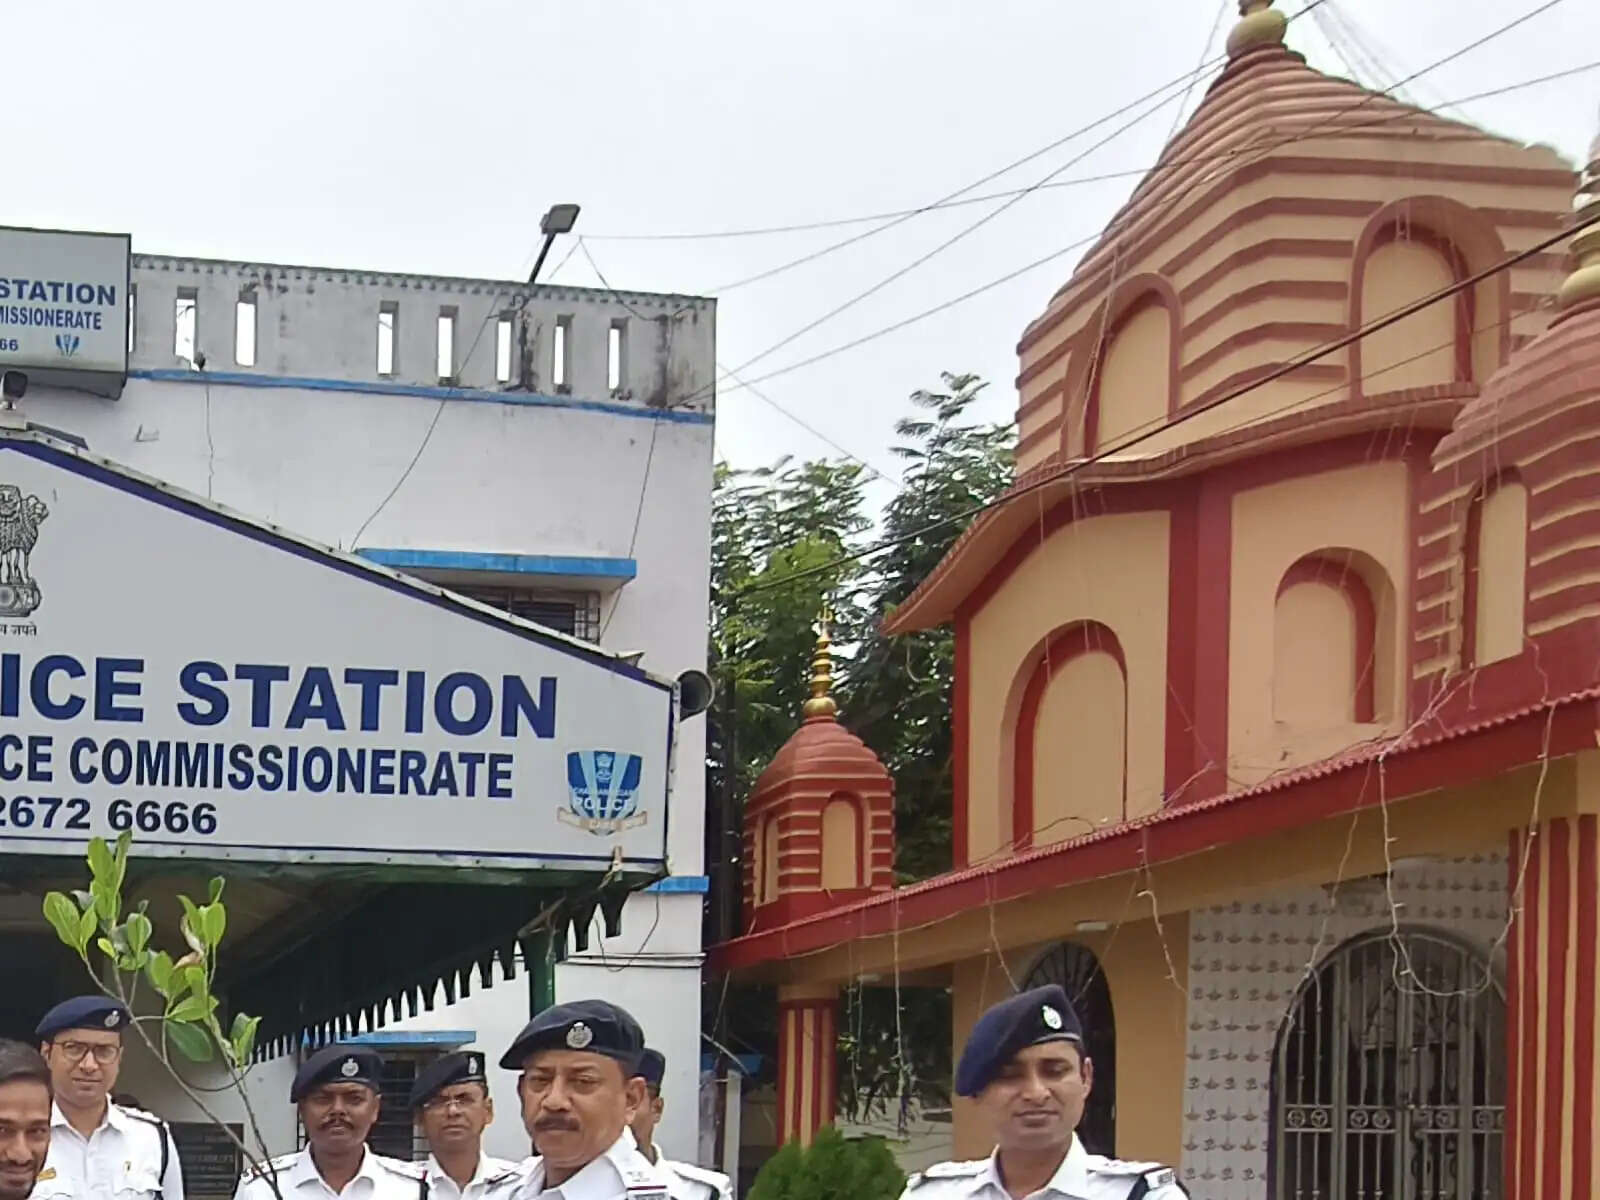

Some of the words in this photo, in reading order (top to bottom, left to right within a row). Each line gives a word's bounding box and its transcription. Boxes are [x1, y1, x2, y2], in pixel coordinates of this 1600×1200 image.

[177, 661, 558, 738] STATION
[70, 738, 513, 798] COMMISSIONERATE
[108, 797, 217, 834] 6666
